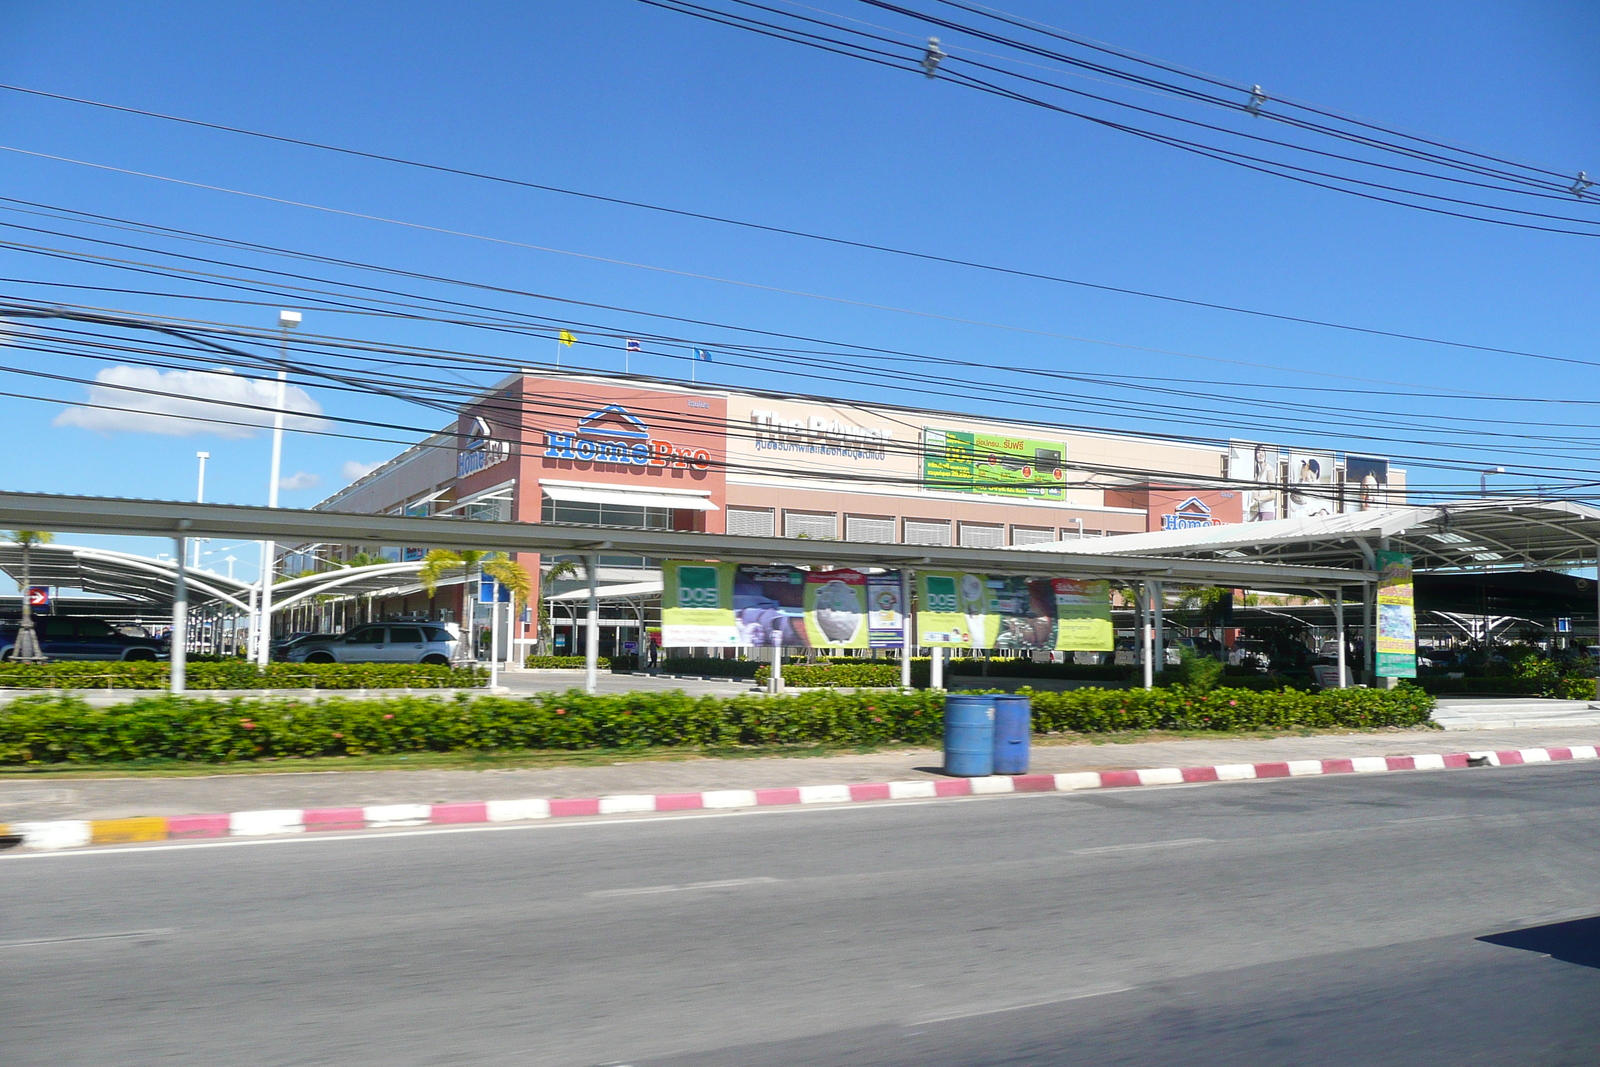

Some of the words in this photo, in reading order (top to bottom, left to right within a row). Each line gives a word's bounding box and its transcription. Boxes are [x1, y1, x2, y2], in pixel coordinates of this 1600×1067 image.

[751, 408, 804, 435] The
[807, 416, 893, 446] Power
[457, 440, 510, 479] HomePro
[543, 430, 712, 471] HomePro
[1162, 514, 1229, 530] HomeP
[680, 586, 719, 603] DOS
[927, 594, 957, 607] DOS
